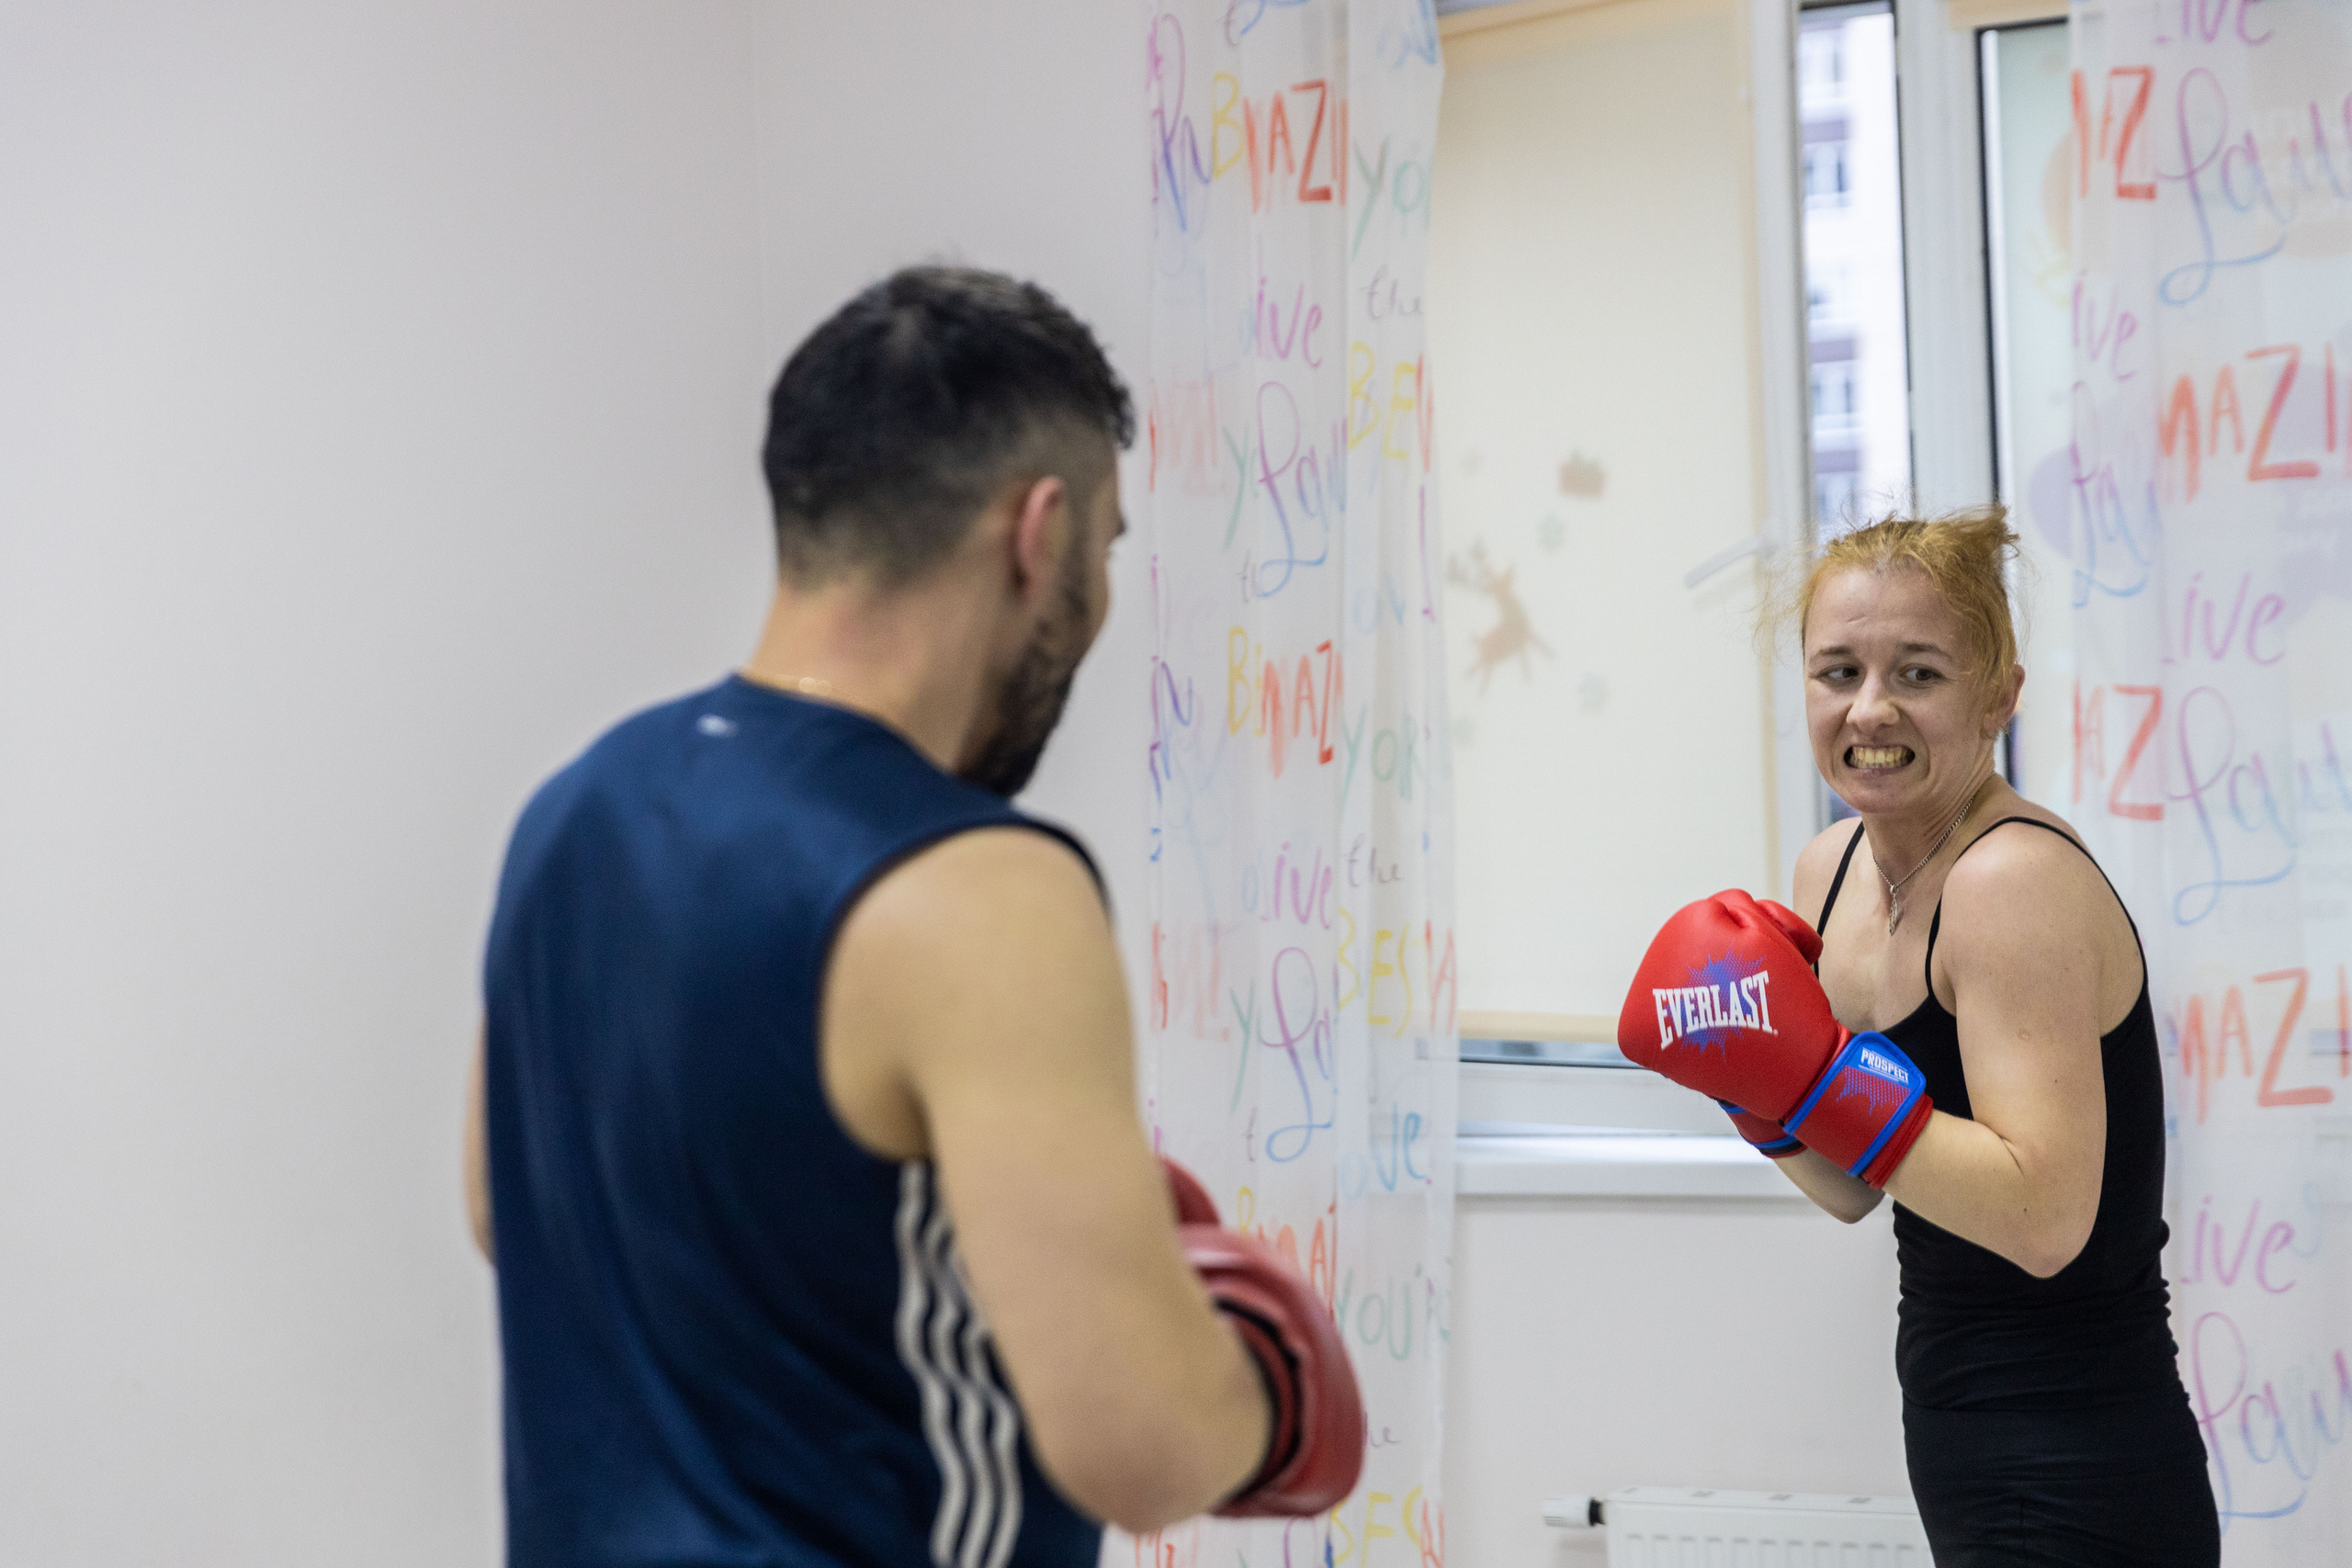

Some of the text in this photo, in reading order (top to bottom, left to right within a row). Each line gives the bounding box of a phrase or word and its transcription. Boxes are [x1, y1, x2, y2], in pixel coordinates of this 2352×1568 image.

[1255, 275, 1323, 368] ive
[2162, 571, 2288, 667] ive
[1260, 840, 1332, 931] ive
[1653, 970, 1773, 1050] EVERLAST
[1861, 1047, 1909, 1084] PROSPECT
[2179, 1194, 2297, 1293] ive
